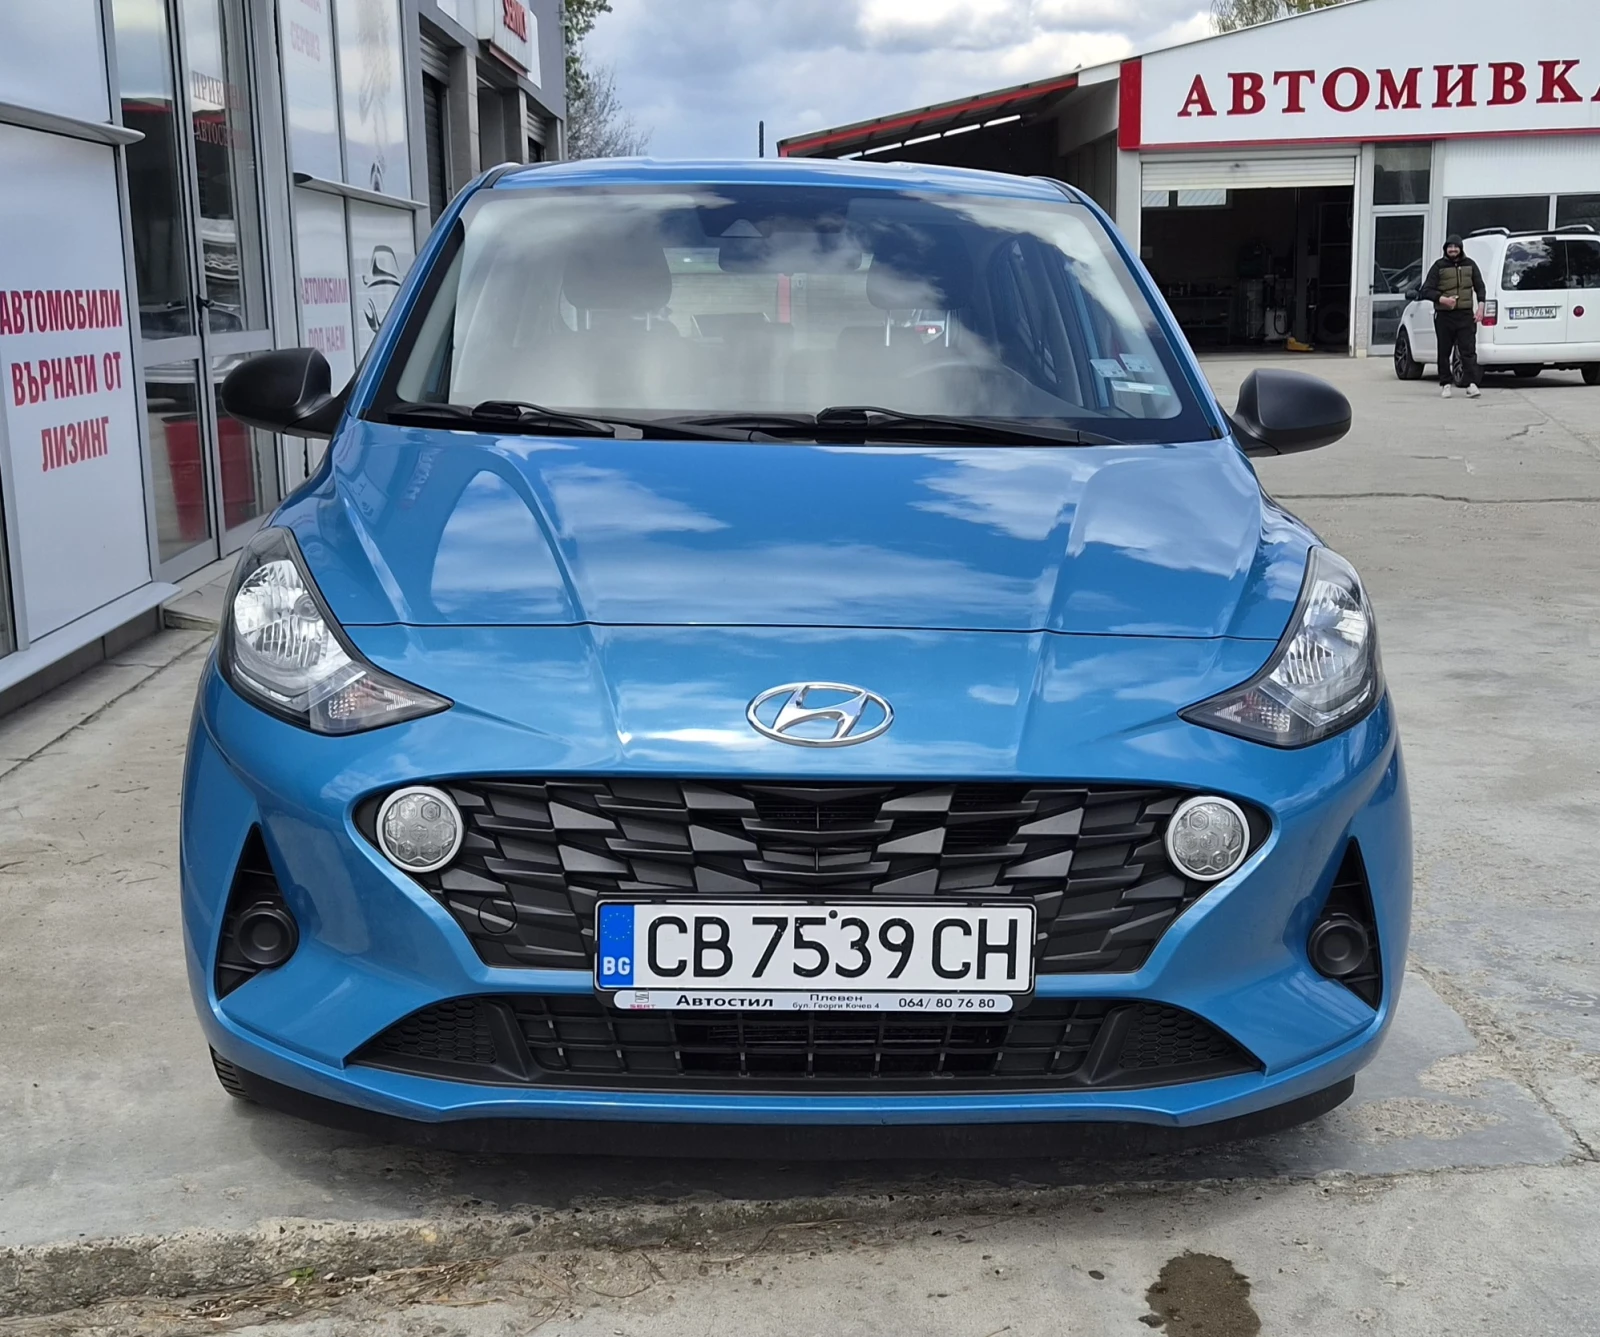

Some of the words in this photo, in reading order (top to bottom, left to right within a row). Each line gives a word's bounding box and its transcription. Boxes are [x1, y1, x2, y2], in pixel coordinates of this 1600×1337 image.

[1177, 59, 1600, 117] АВТОМИВК
[0, 289, 123, 335] АВТОМОБИЛИ
[11, 353, 98, 406] ВЪРНАТИ
[103, 351, 122, 391] ОТ
[41, 416, 109, 472] ЛИЗИНГ
[602, 956, 631, 976] BG
[647, 916, 733, 978] CB
[751, 916, 915, 979] 7539
[931, 918, 1018, 980] CH
[676, 994, 774, 1008] Автостил
[792, 1002, 811, 1010] бул.
[813, 1002, 843, 1010] Георги
[898, 998, 931, 1008] 064/
[935, 998, 953, 1008] 80
[957, 998, 974, 1008] 76
[977, 999, 995, 1008] 80
